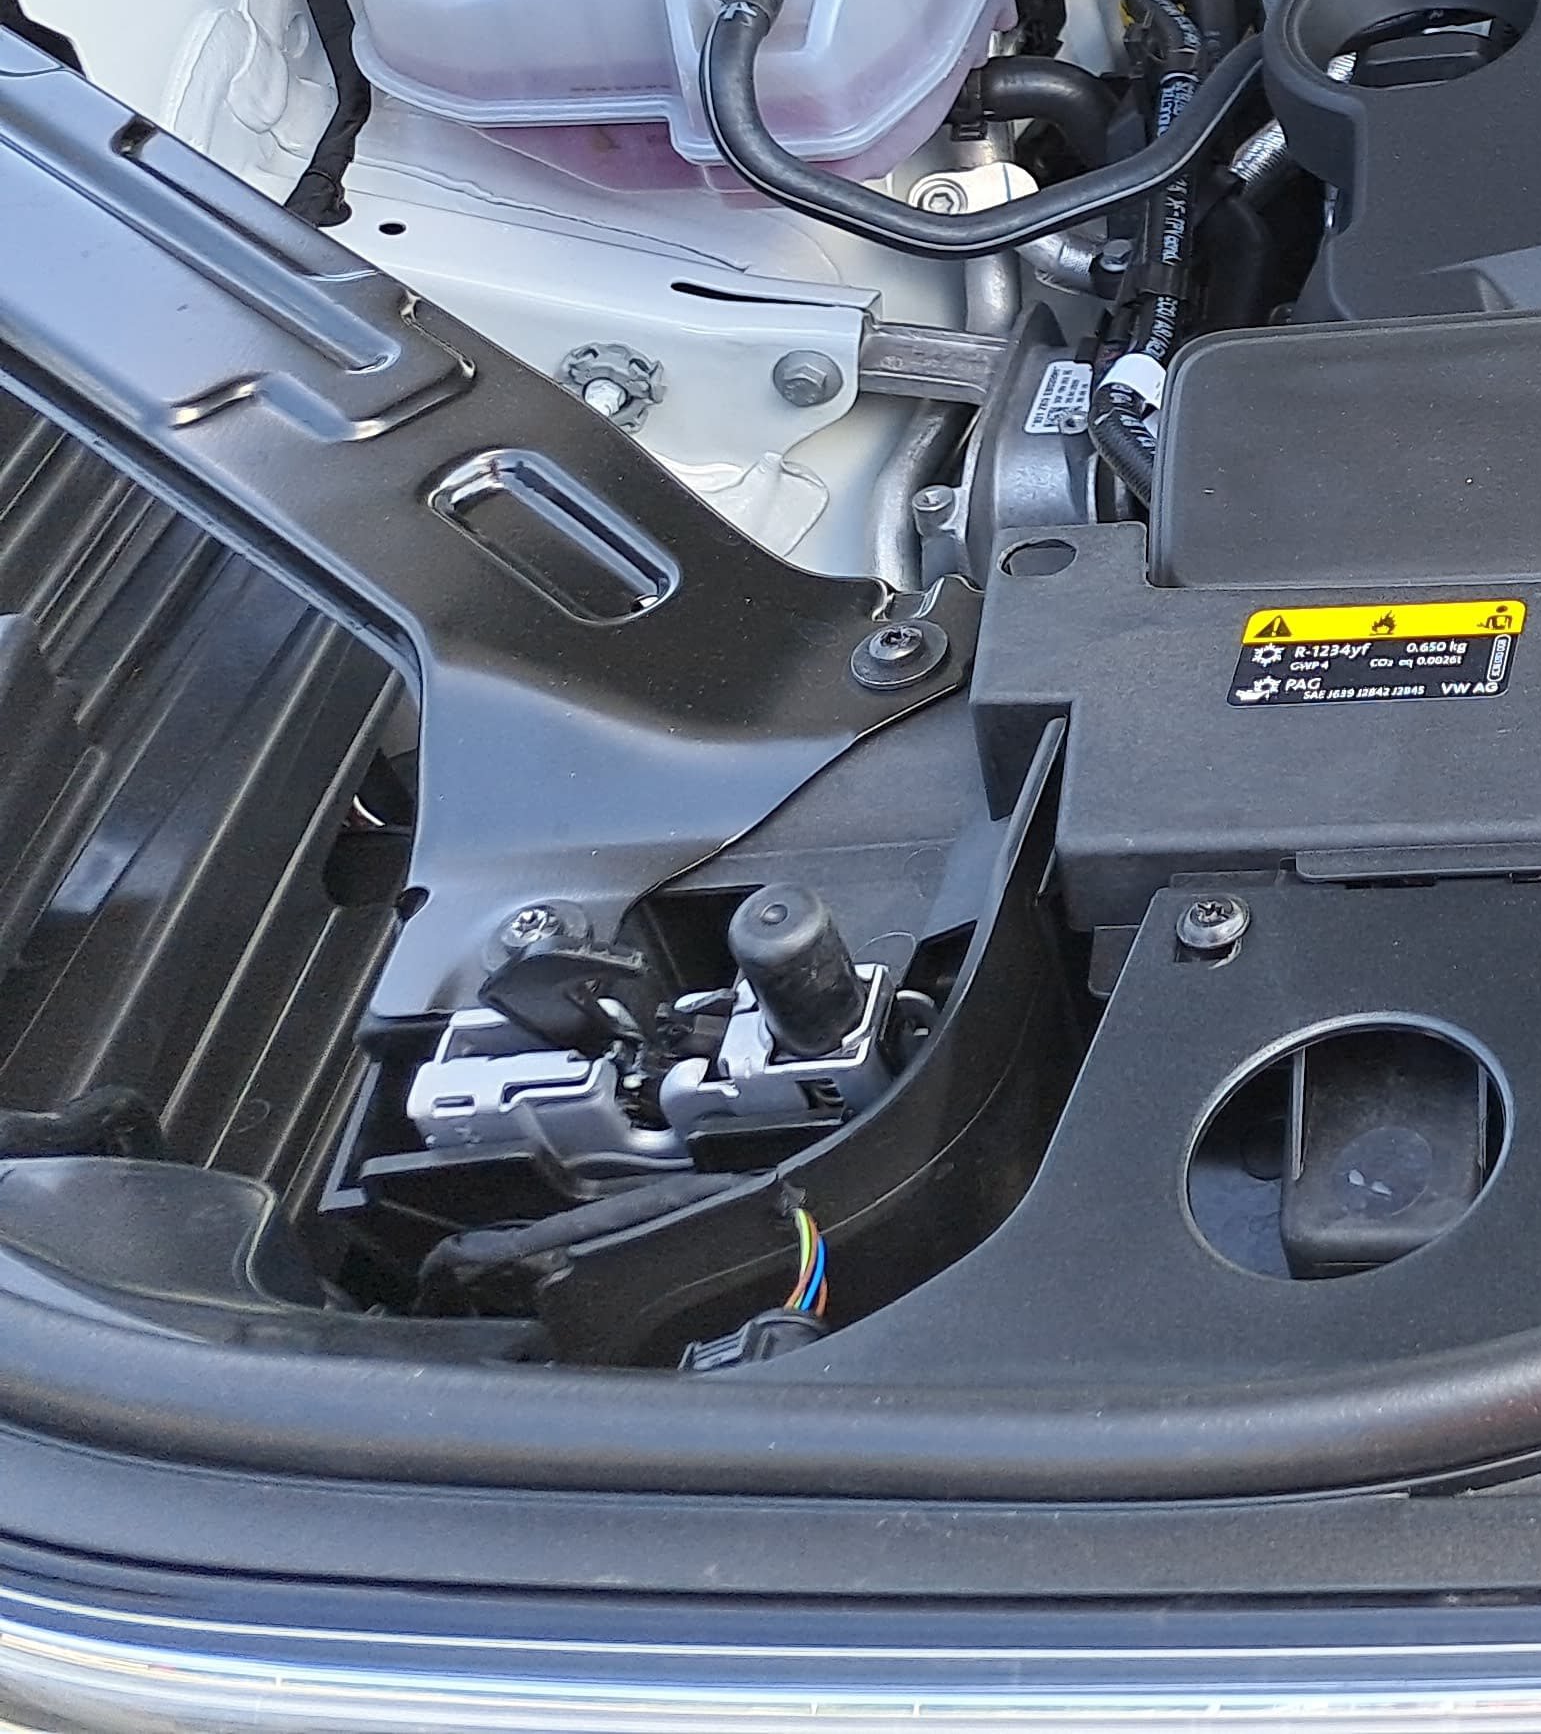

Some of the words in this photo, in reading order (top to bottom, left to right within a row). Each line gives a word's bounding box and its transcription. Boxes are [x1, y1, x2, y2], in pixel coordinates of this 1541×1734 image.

[1294, 642, 1372, 659] R-1234yf
[1405, 642, 1447, 654] 0.650
[1449, 639, 1468, 654] kg
[1290, 660, 1320, 671] GWP
[1321, 660, 1330, 670] 4
[1285, 677, 1322, 691] PAG
[1441, 681, 1472, 696] VW
[1472, 681, 1499, 694] AG
[1303, 689, 1326, 700] SAE
